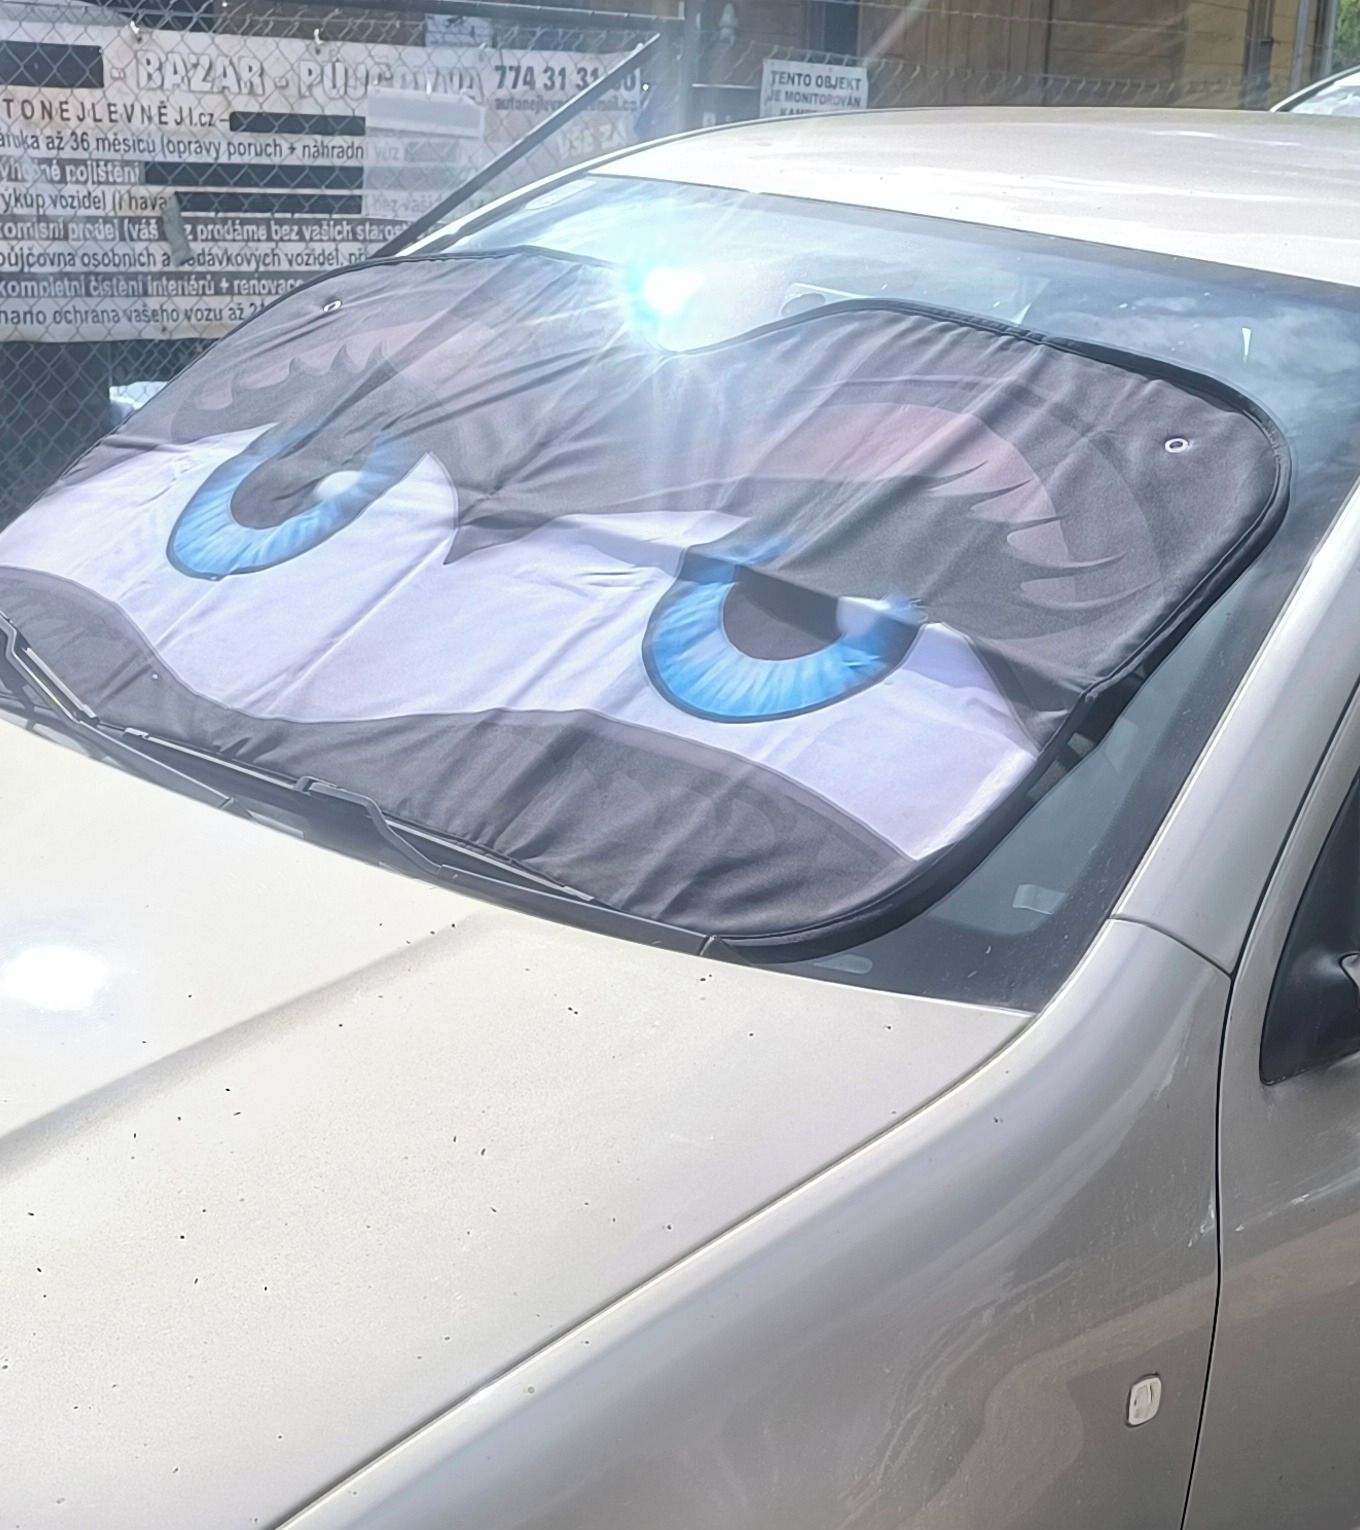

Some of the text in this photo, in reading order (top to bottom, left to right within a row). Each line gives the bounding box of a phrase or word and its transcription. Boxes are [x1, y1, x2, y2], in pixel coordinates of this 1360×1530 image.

[136, 50, 265, 96] BAZAR
[494, 64, 537, 90] 774
[543, 65, 566, 91] 31
[770, 70, 862, 91] TENTO OBJEKT
[766, 88, 862, 108] JE MONITOROVÁN
[45, 131, 65, 152] až
[70, 132, 91, 152] 36
[227, 138, 283, 161] poruch
[302, 138, 365, 160] náhradn
[51, 189, 107, 212] vozidel
[197, 219, 267, 243] prodáme
[270, 220, 299, 240] bez
[303, 220, 353, 242] vašich
[81, 248, 156, 268] osobních
[161, 251, 171, 267] a
[52, 304, 121, 325] ochrana
[126, 303, 180, 323] vašeho
[185, 305, 223, 322] vozu
[229, 302, 245, 321] až
